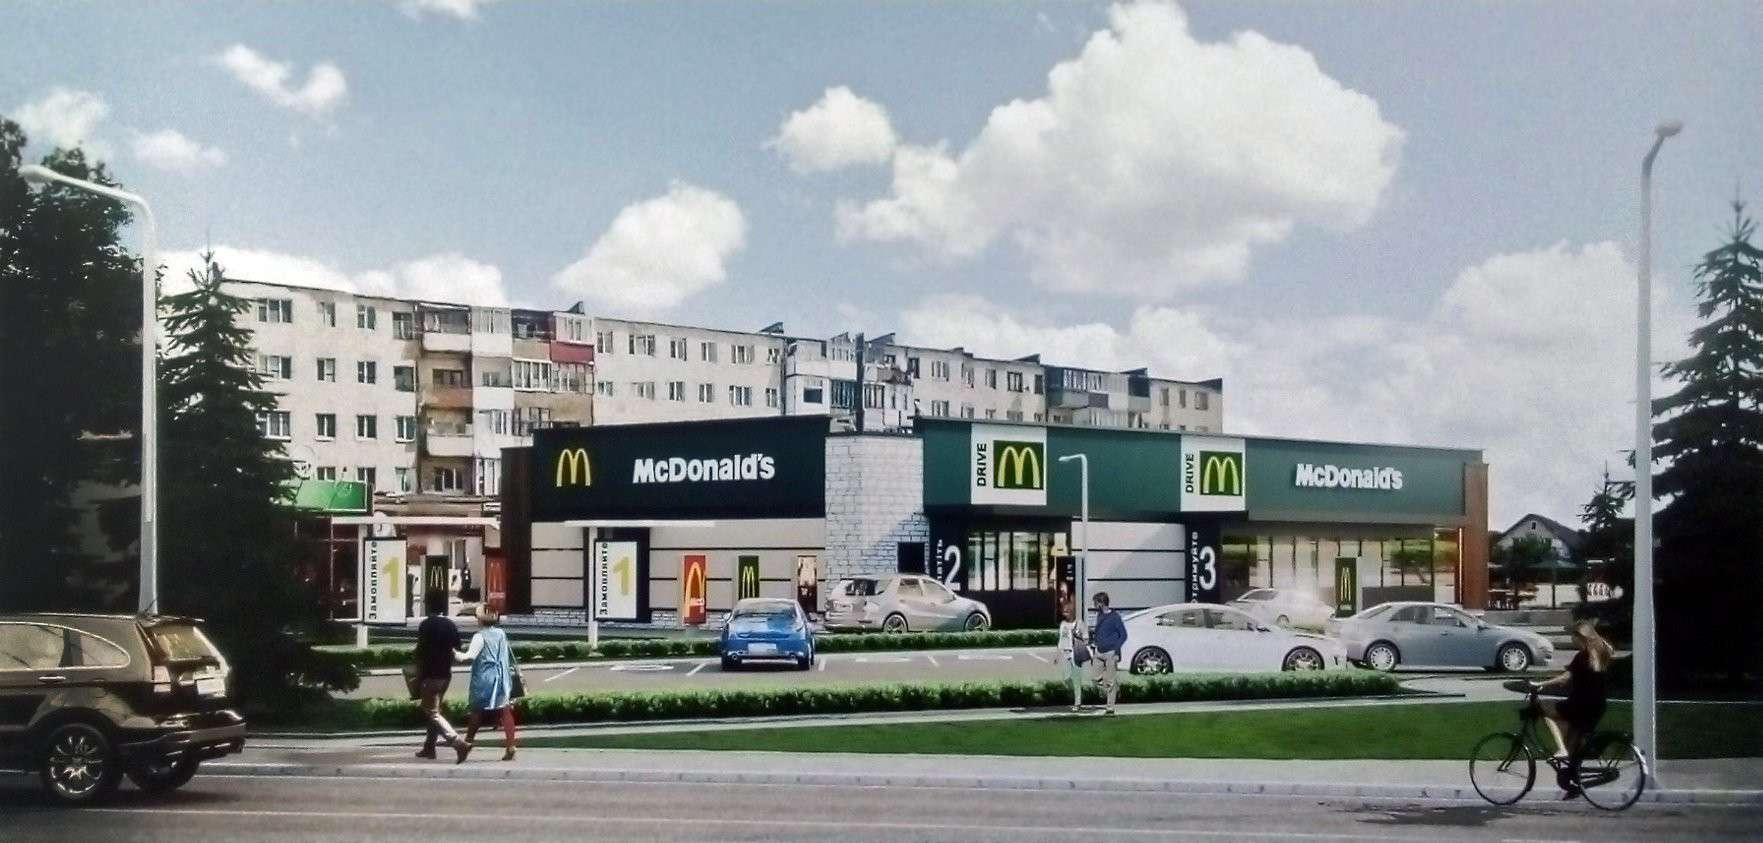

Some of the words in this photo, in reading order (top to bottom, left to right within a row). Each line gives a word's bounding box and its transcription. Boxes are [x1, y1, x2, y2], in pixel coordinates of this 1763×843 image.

[632, 453, 776, 484] McDonald's
[977, 443, 987, 487] DRIVE
[1185, 453, 1194, 493] DRIVE
[1295, 463, 1403, 490] McDonald's
[382, 556, 400, 599] 1
[613, 556, 629, 596] 1
[944, 545, 961, 592] 2
[1199, 545, 1217, 590] 3
